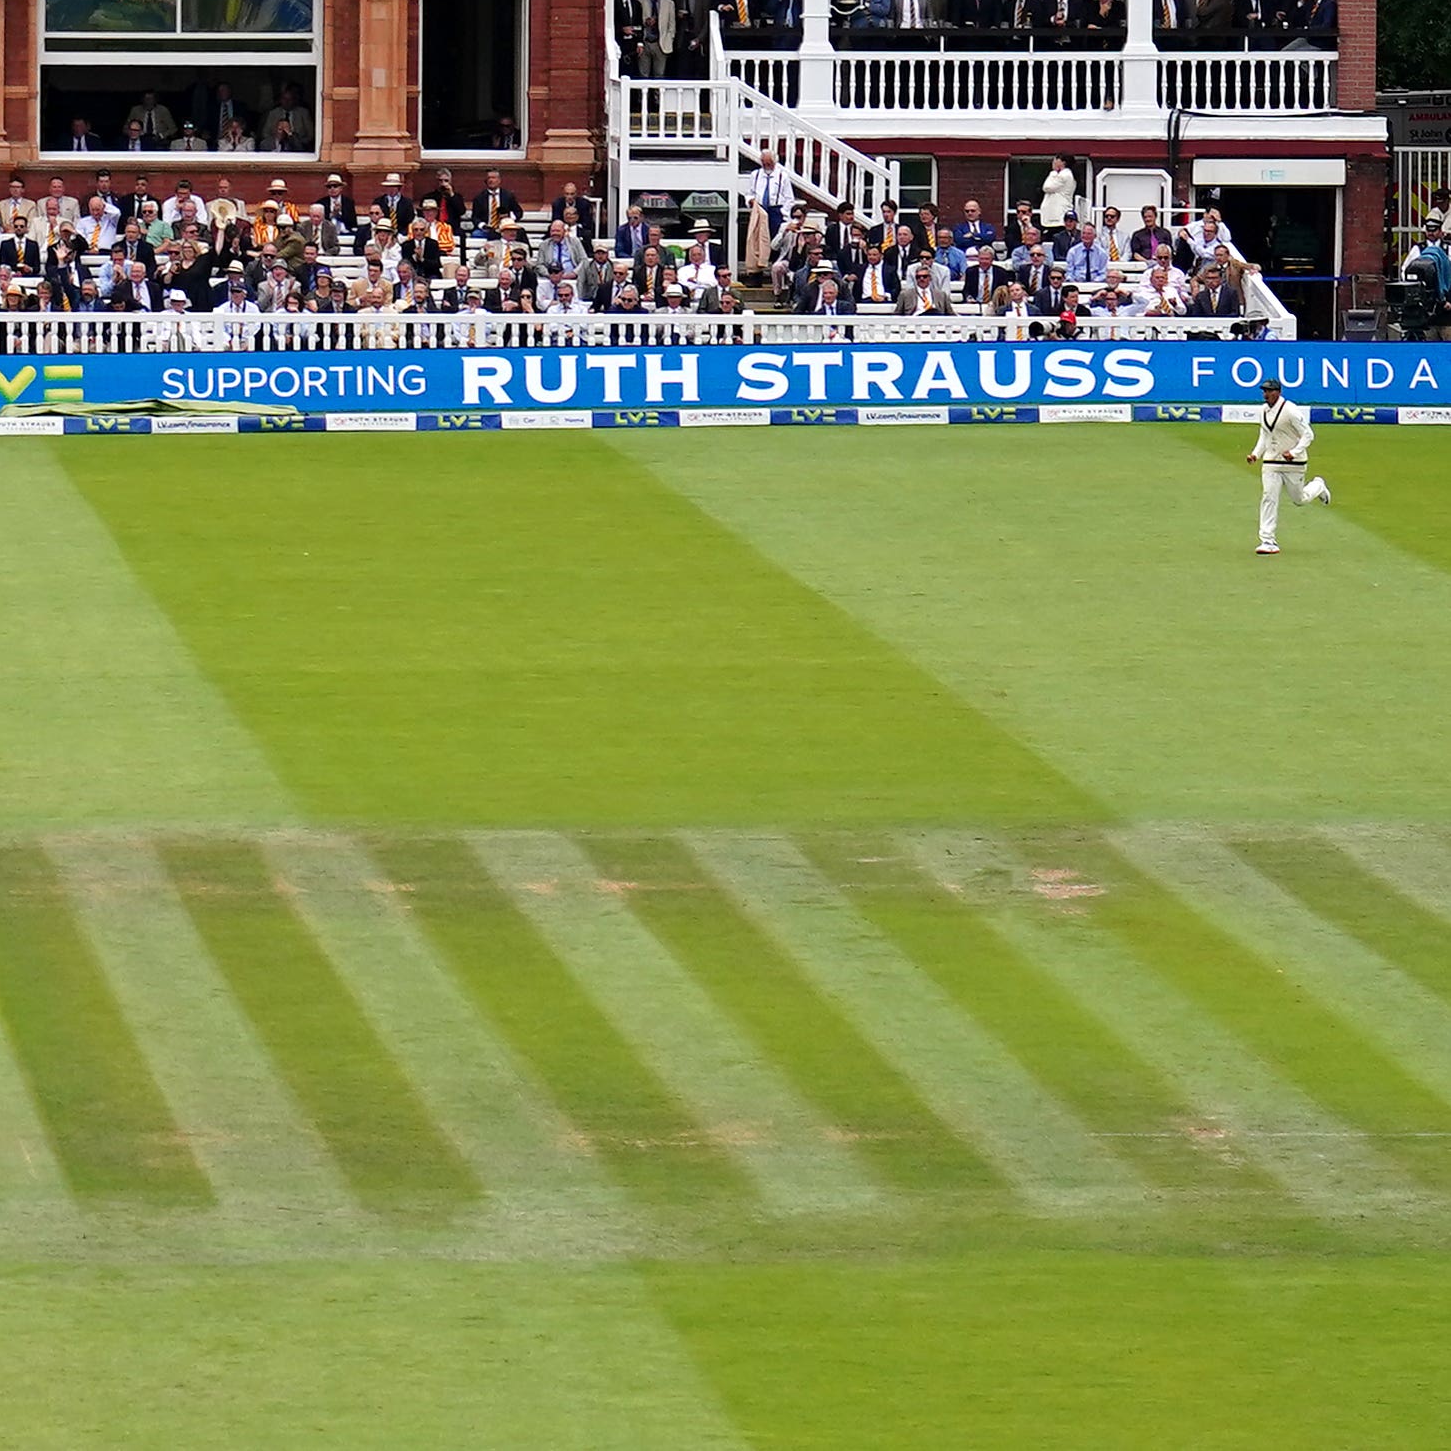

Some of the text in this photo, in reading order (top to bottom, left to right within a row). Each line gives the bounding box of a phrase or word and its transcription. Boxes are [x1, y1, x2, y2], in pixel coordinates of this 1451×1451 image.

[161, 364, 426, 398] SUPPORTING
[462, 354, 700, 404] RUTH
[736, 348, 1154, 402] STRAUSS
